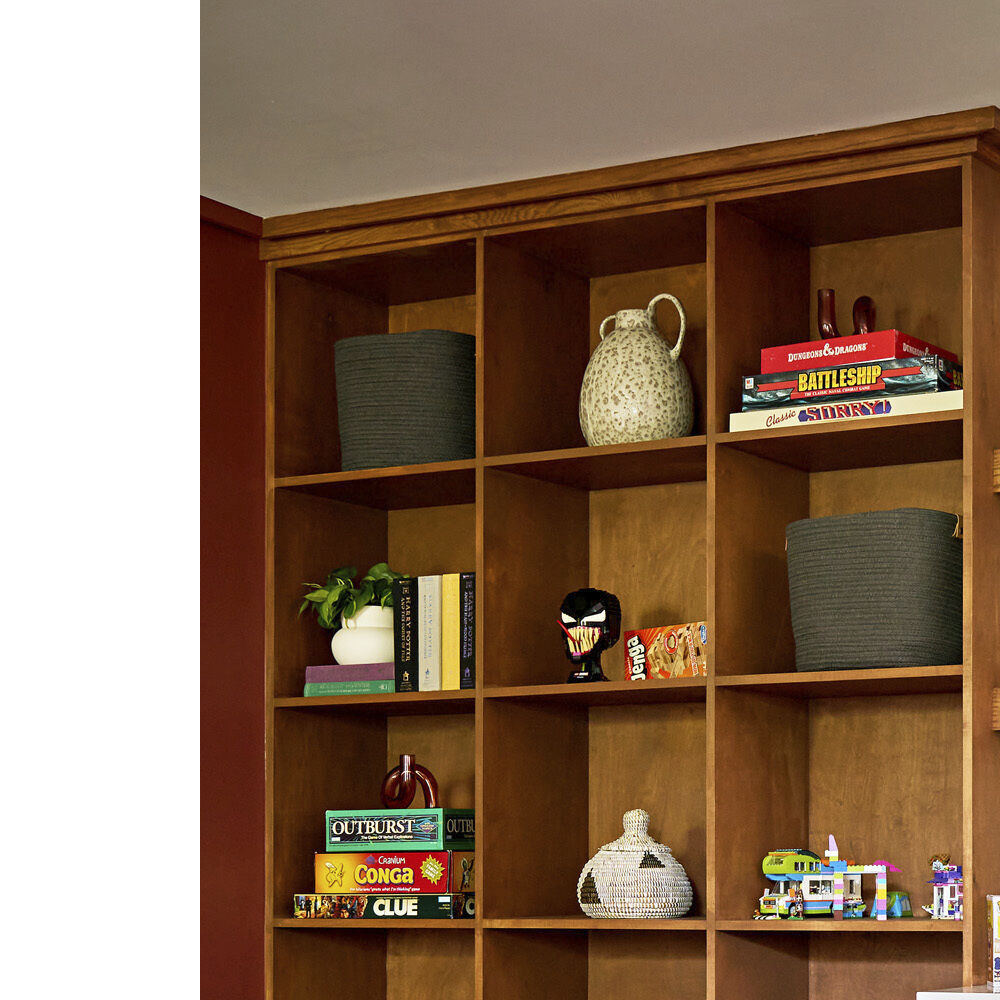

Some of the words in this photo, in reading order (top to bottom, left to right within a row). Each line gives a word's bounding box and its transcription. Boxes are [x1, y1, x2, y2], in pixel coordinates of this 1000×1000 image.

[788, 350, 822, 362] DUNGEONS
[822, 343, 834, 356] &
[835, 343, 867, 355] DRAGONS
[798, 365, 882, 392] BATTLESHIP
[766, 410, 796, 427] Classic
[806, 400, 888, 421] SORRY!
[627, 635, 646, 680] Jenga
[332, 819, 416, 835] OUTBURST
[373, 898, 418, 916] CLUE
